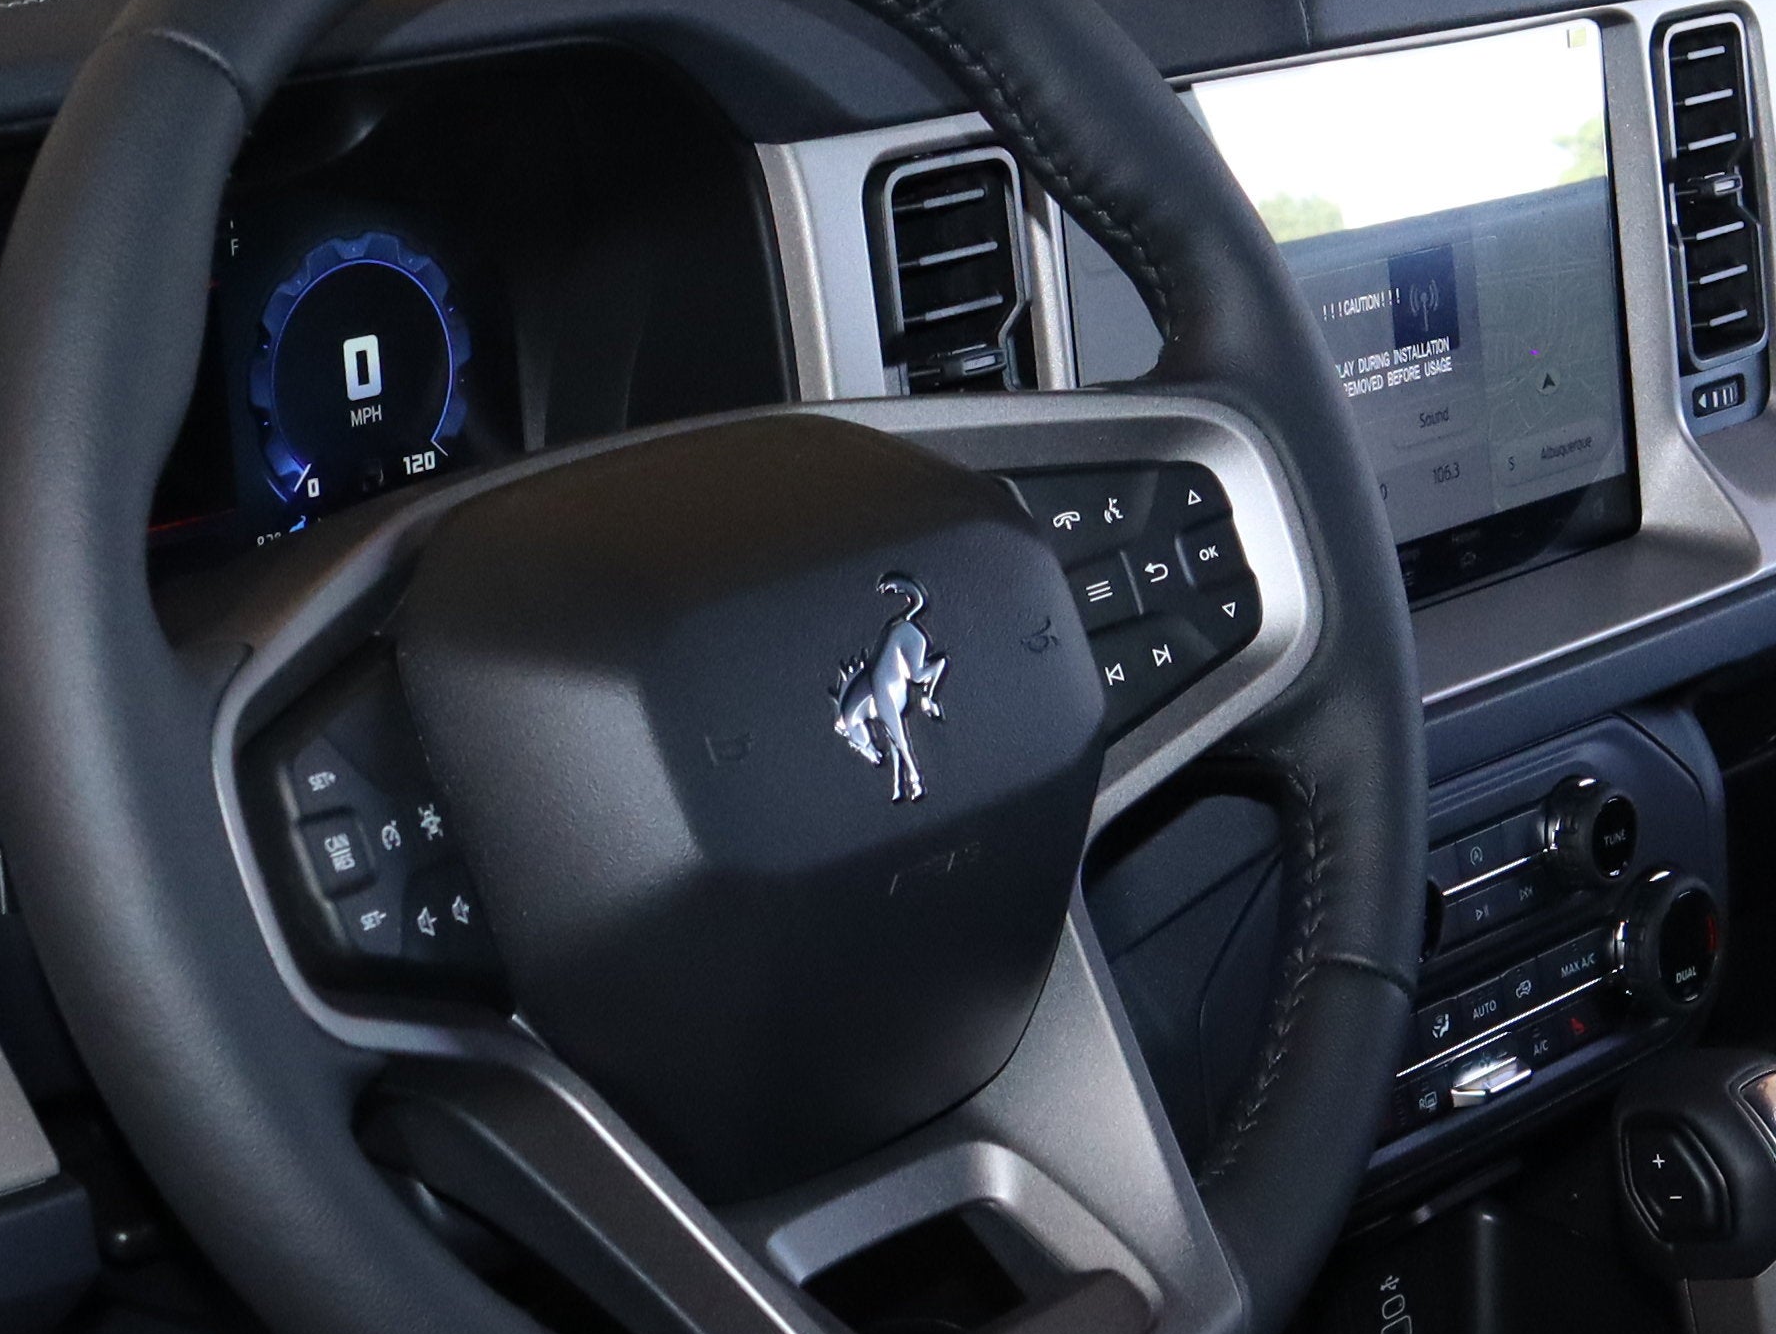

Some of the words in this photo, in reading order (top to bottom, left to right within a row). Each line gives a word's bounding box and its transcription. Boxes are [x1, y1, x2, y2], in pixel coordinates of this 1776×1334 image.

[230, 238, 240, 257] F
[1358, 352, 1390, 374] DURING
[1393, 336, 1450, 365] INSTALLATION
[343, 333, 382, 401] 0
[1387, 365, 1421, 387] BEFORE
[1425, 356, 1452, 377] USAGE
[350, 404, 383, 427] MPH
[402, 450, 436, 475] 120
[307, 477, 320, 498] 0
[1198, 545, 1220, 561] OK
[1603, 828, 1628, 847] TUNE
[1560, 959, 1581, 978] MAX
[1581, 952, 1596, 969] A/C
[1675, 965, 1697, 984] DUAL
[1472, 999, 1497, 1020] AUTO
[1533, 1039, 1550, 1057] A/C
